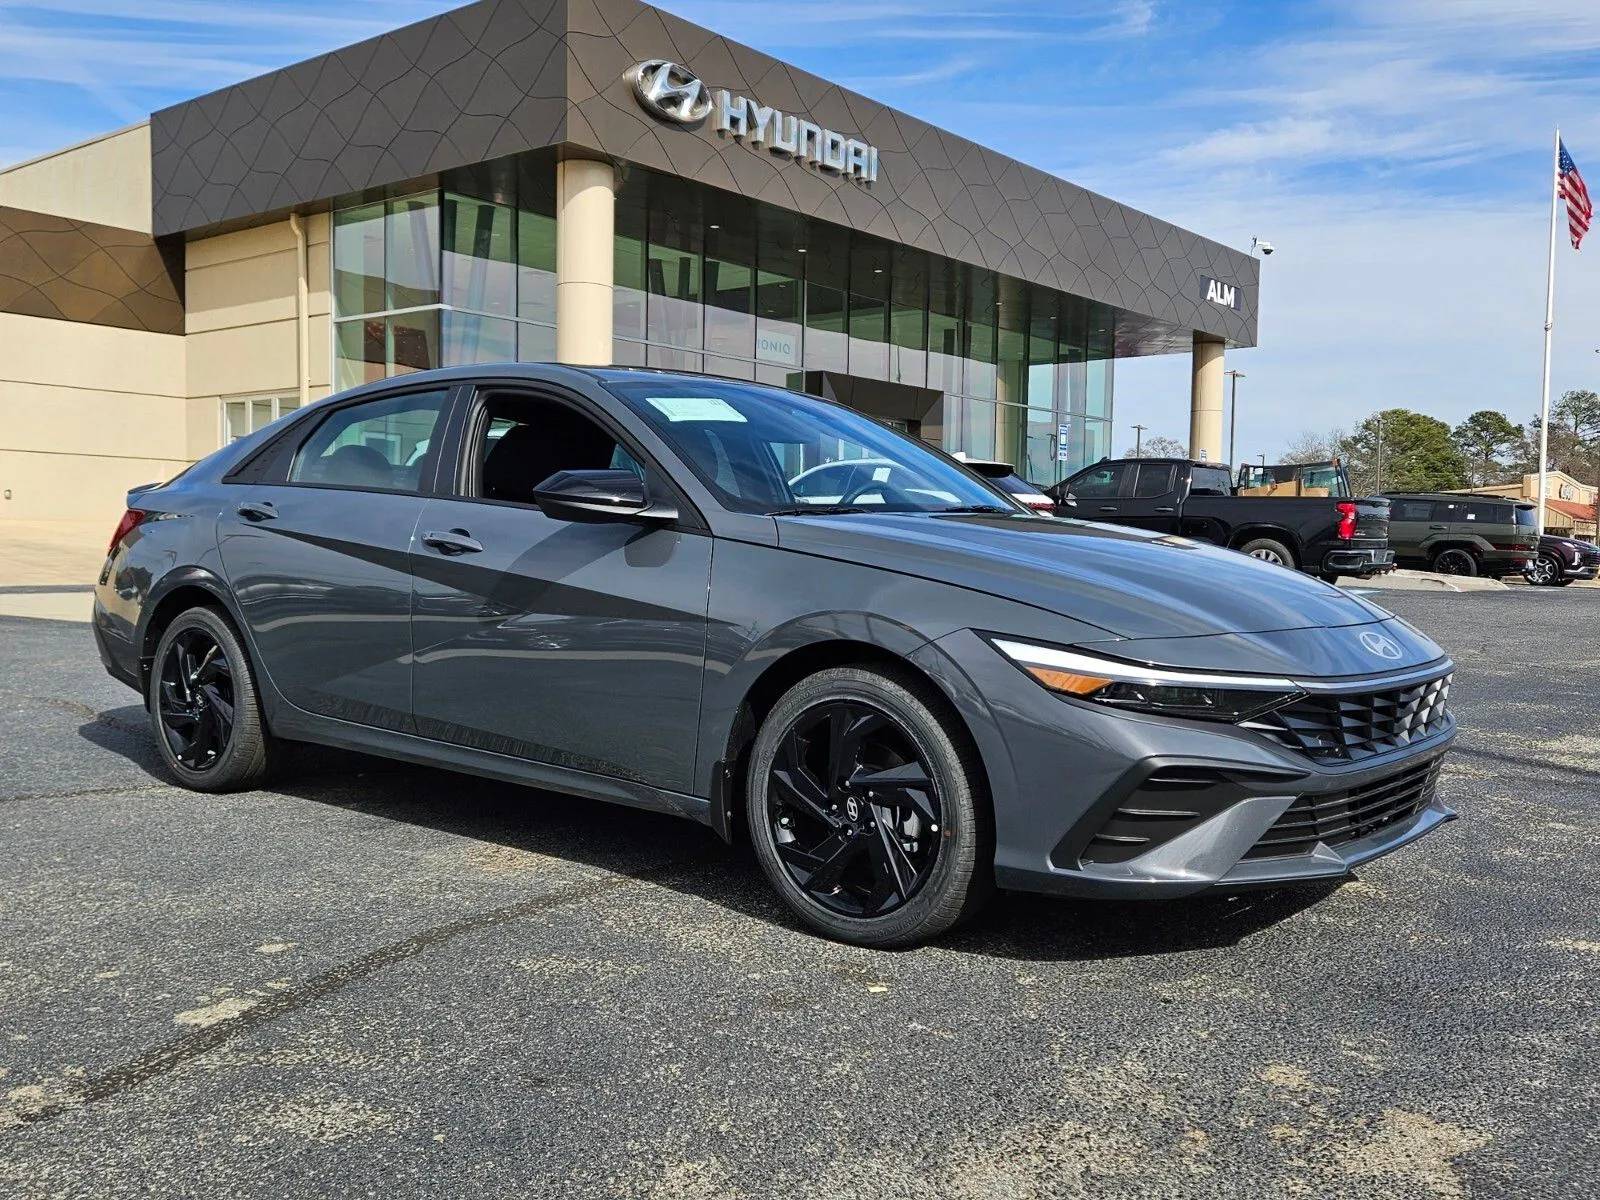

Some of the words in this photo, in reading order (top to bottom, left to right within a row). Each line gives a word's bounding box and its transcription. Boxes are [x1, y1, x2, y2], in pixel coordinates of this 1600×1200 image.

[717, 89, 878, 183] HYUNDAI
[1206, 279, 1235, 308] ALM
[758, 338, 792, 354] IONIQ
